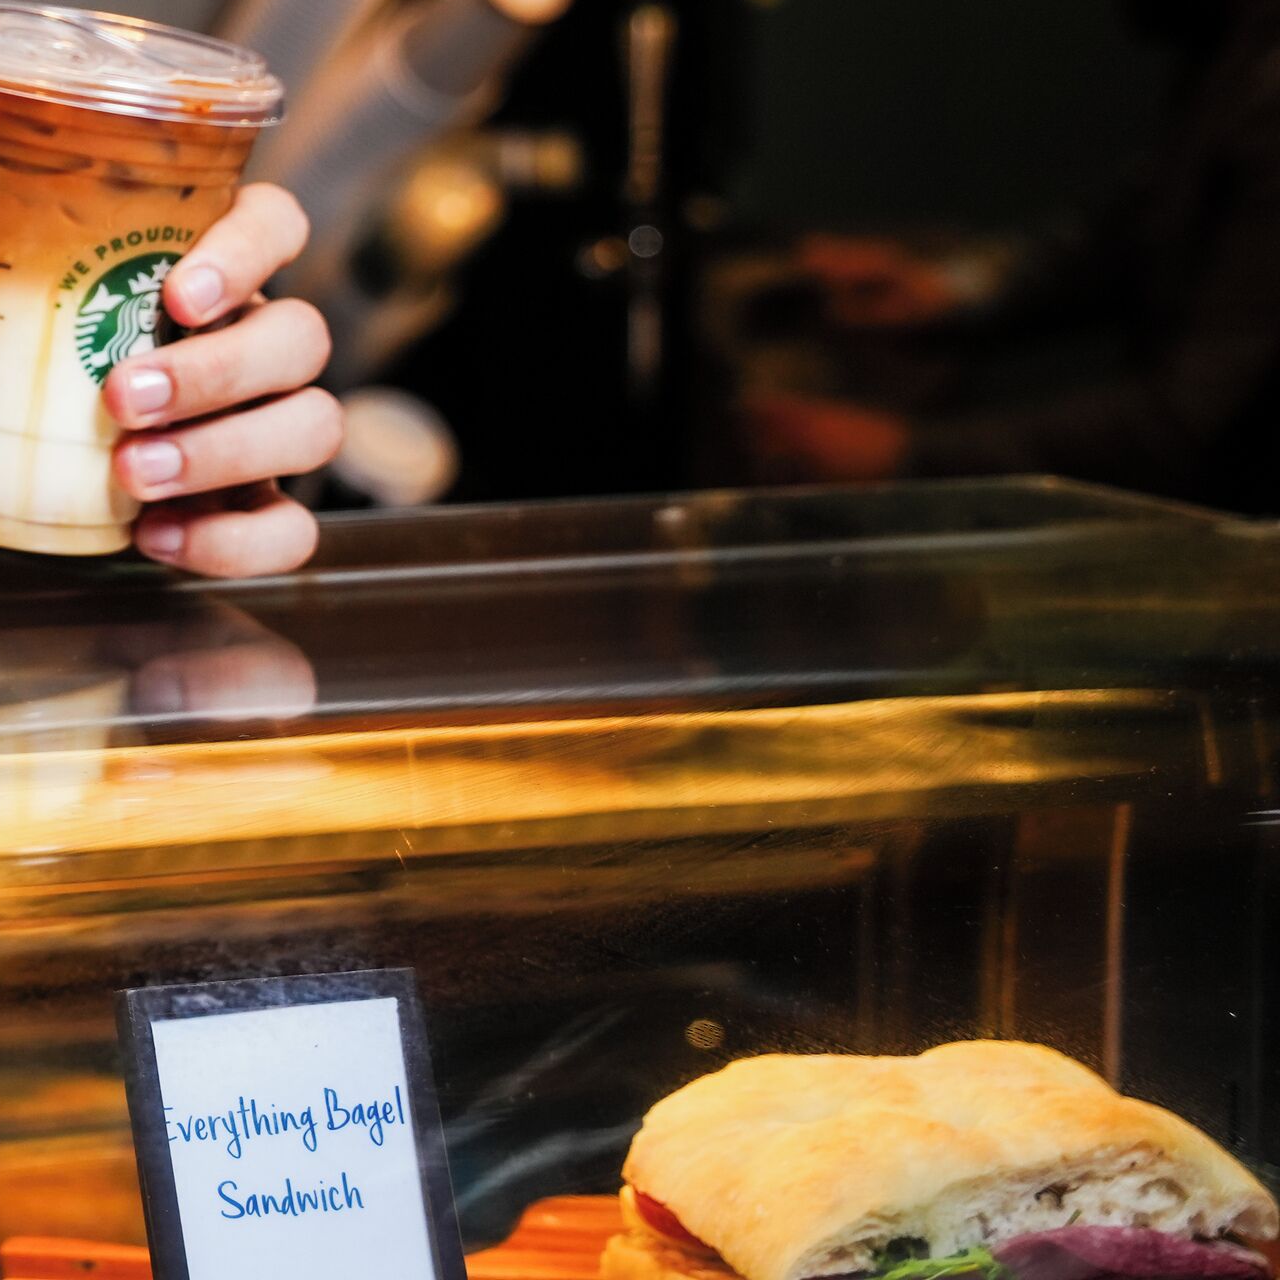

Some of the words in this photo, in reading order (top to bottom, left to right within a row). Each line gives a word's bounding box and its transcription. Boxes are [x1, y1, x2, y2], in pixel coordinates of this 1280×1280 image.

[59, 260, 90, 290] WE
[323, 1085, 405, 1147] Bagel
[217, 1171, 365, 1219] Sandwich
